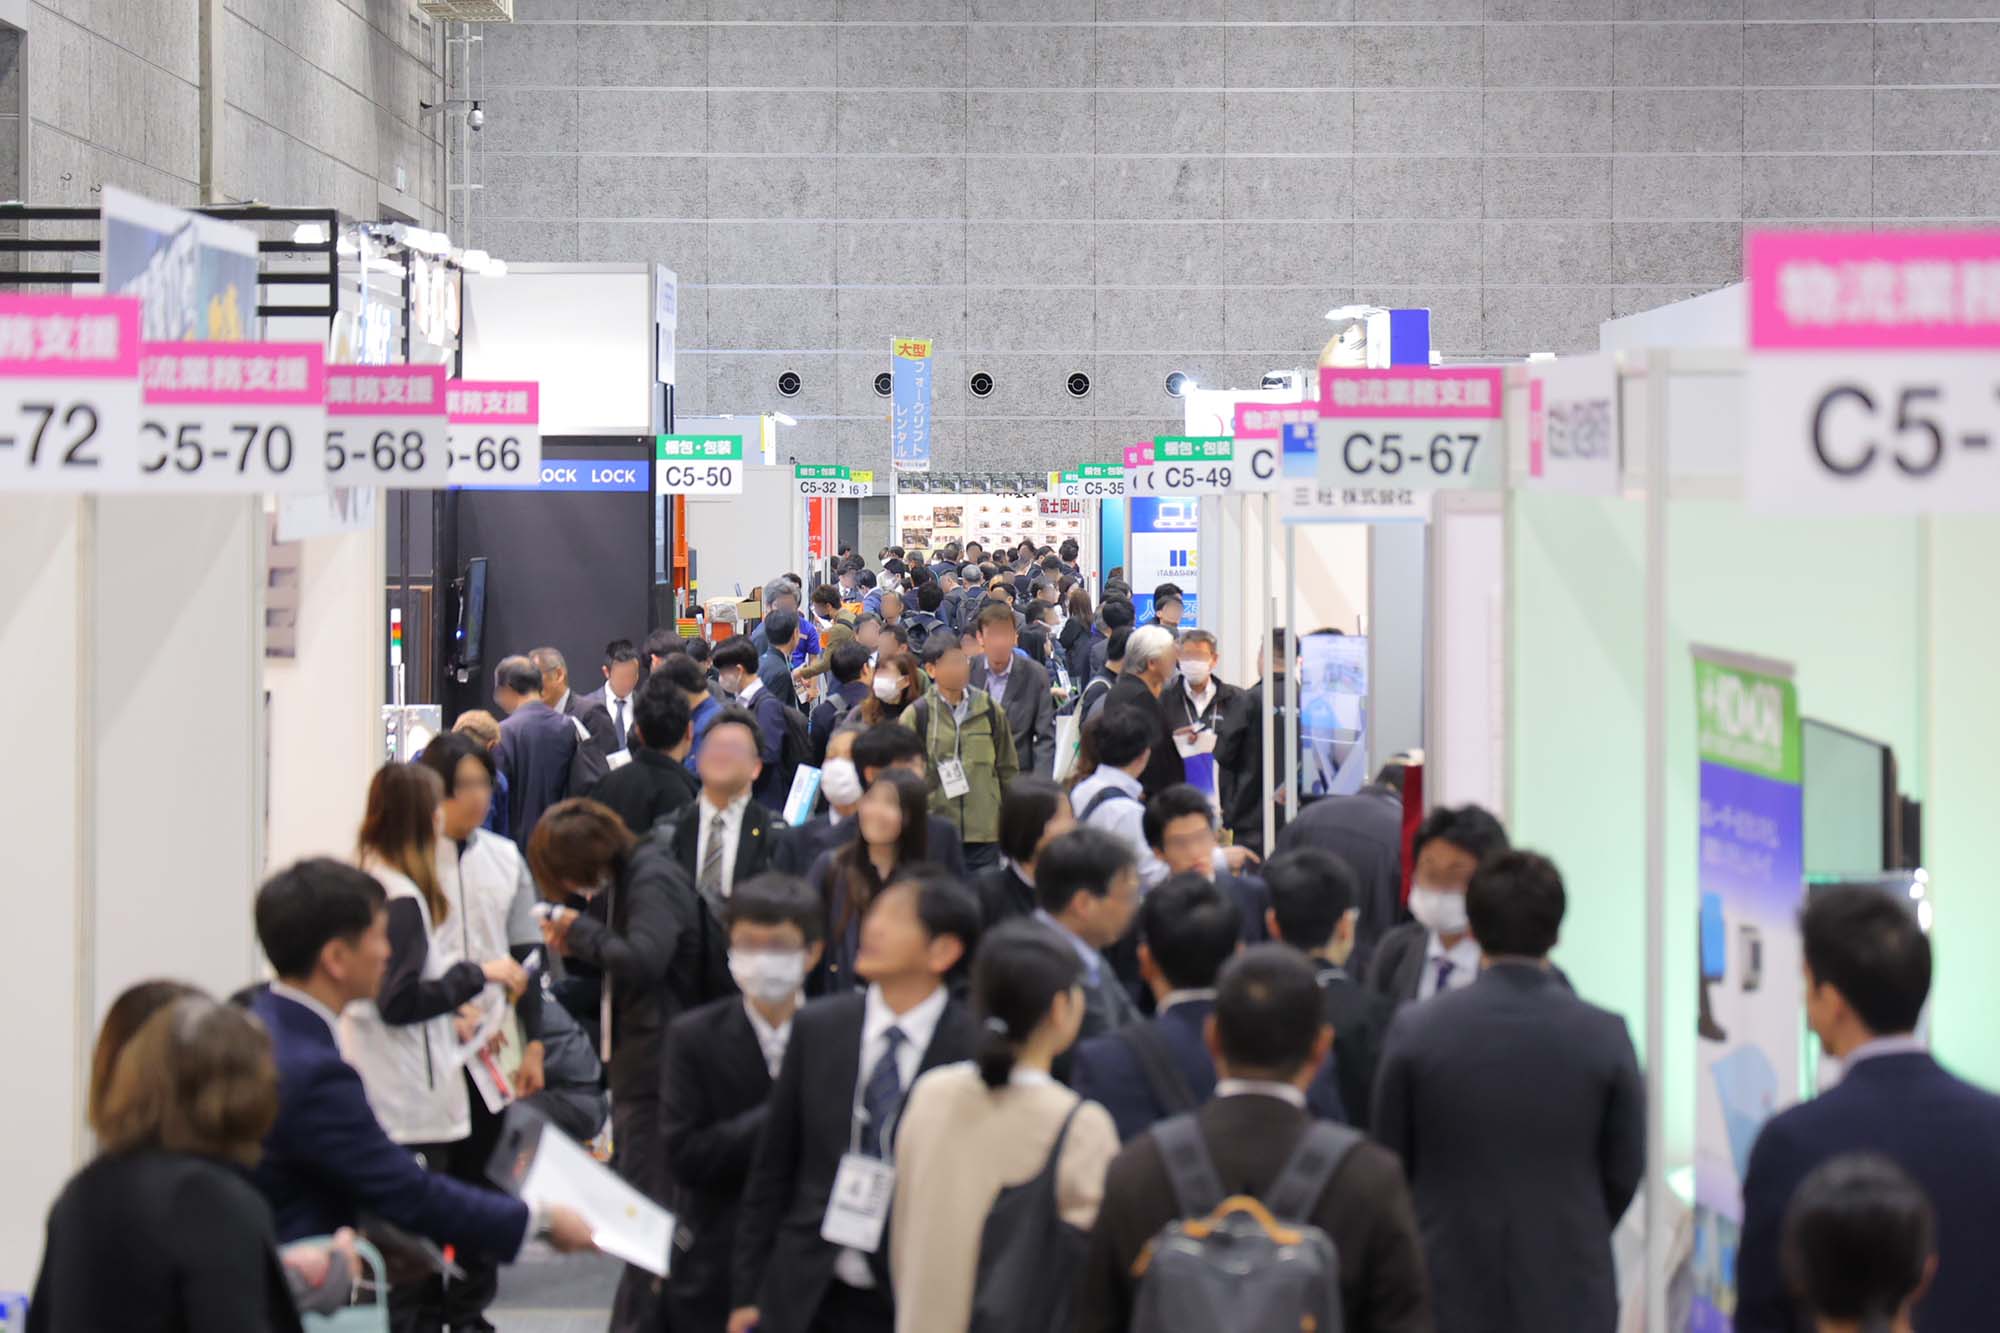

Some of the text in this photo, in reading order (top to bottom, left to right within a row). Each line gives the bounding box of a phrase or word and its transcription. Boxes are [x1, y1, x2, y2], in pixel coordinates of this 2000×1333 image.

[899, 344, 926, 357] 大型
[1331, 379, 1492, 408] 物流業務支援
[912, 361, 926, 457] フォークリフト
[896, 404, 908, 458] レンタル
[665, 441, 732, 455] 梱包・包装
[1165, 441, 1230, 456] 梱包・包装
[1342, 433, 1480, 475] C5-67
[538, 468, 636, 483] OCK LOCK
[665, 466, 732, 487] C5-50
[1165, 467, 1232, 488] C5-49
[800, 482, 837, 493] C5-32
[1084, 482, 1125, 495] C5-35
